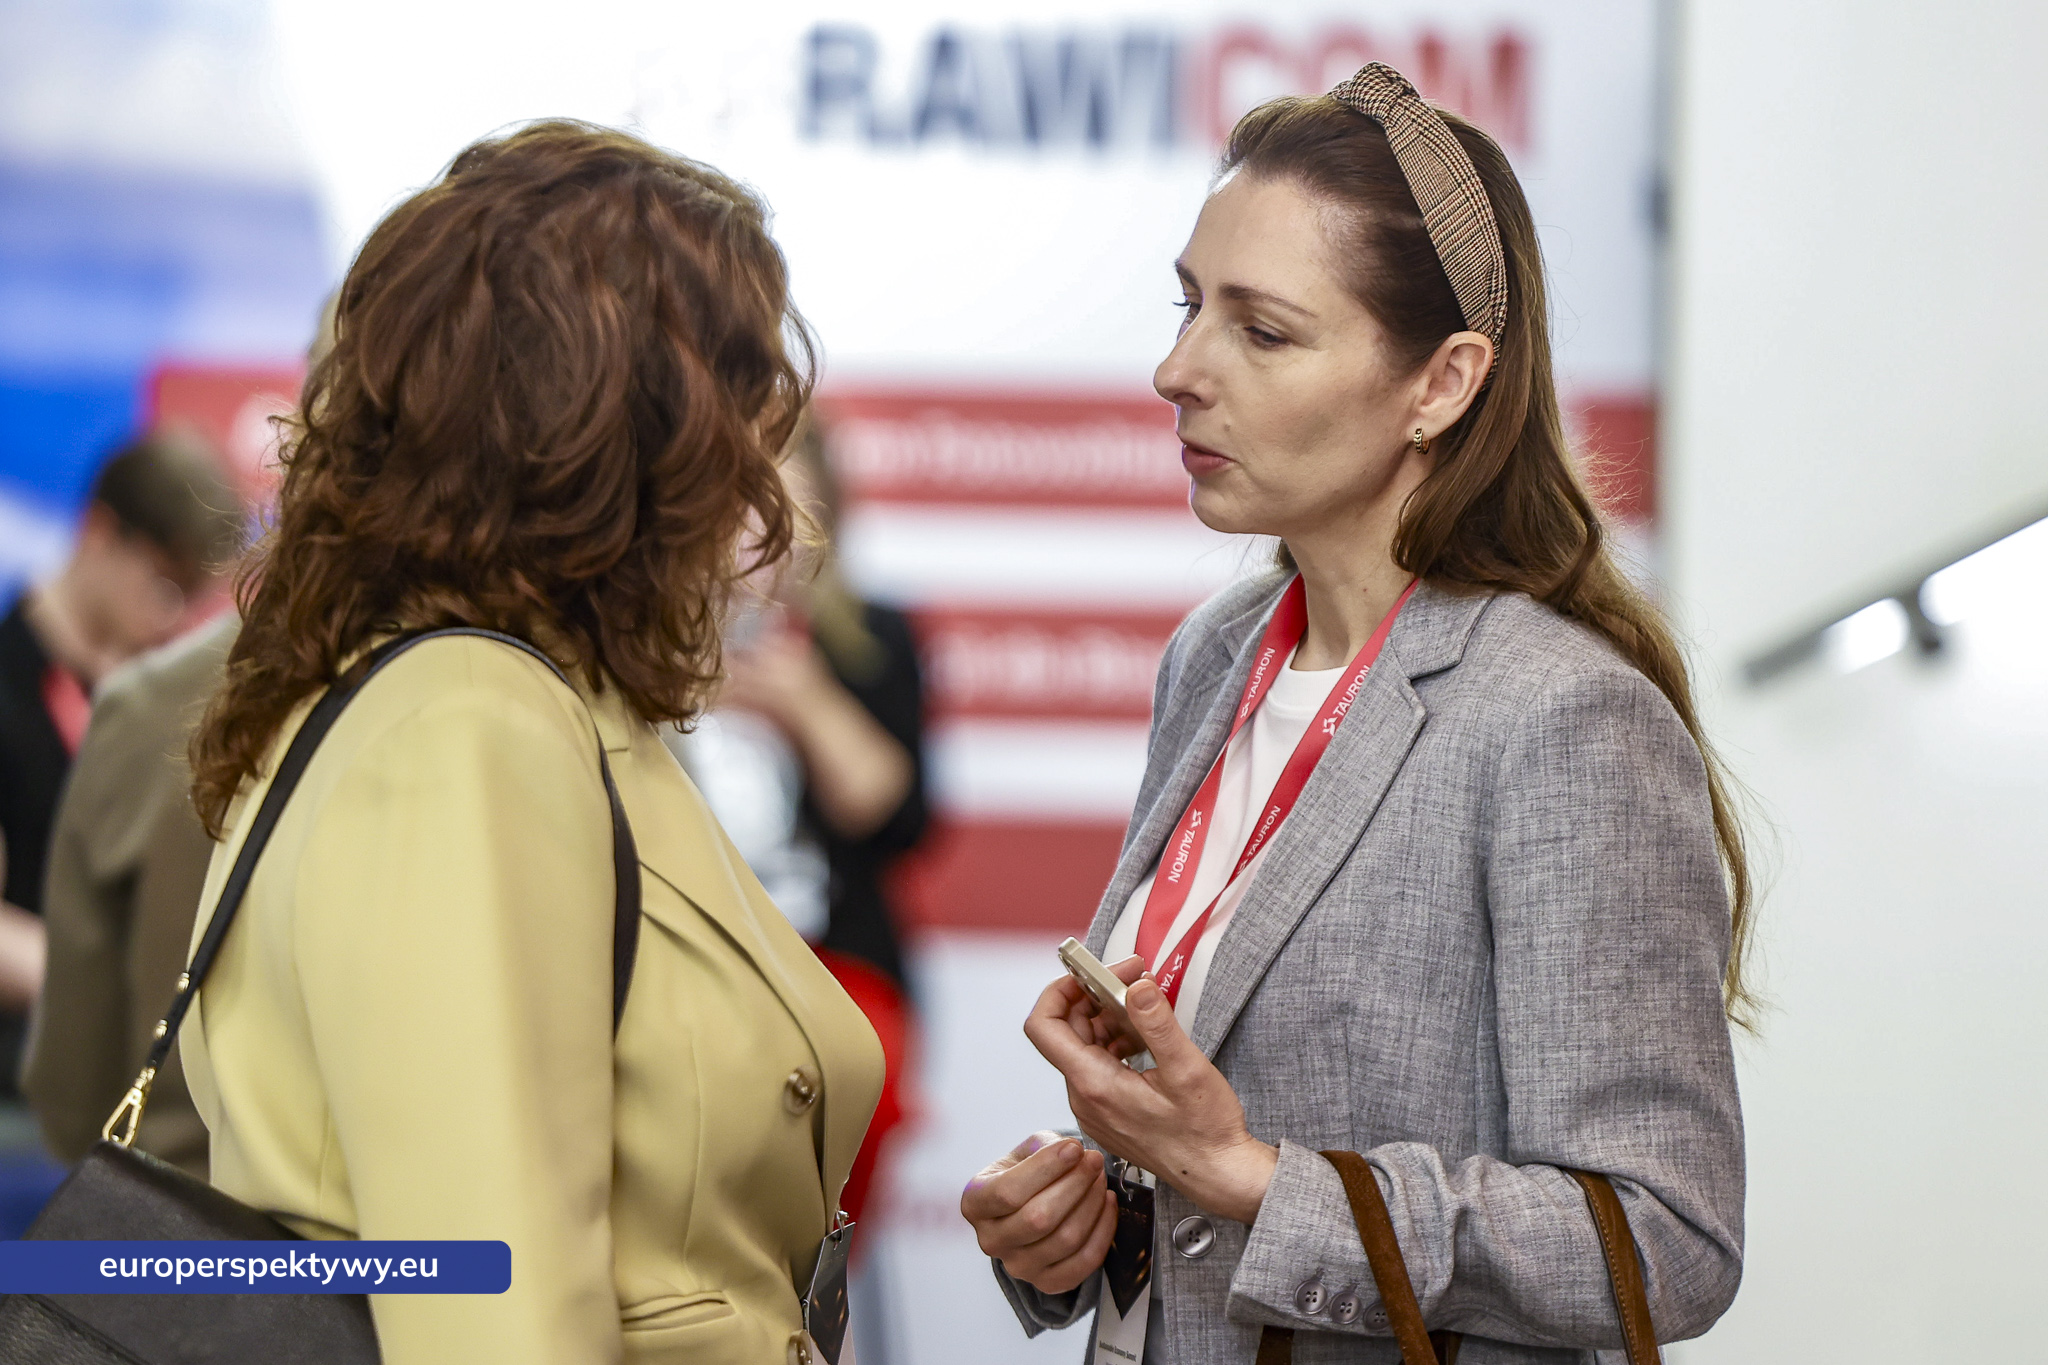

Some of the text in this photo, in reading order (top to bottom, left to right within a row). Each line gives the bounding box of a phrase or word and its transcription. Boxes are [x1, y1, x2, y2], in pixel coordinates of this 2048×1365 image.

[1248, 647, 1276, 700] TAURON
[1332, 664, 1371, 717] TAURON
[1168, 829, 1195, 883] TAURON
[1247, 805, 1281, 857] TAURON
